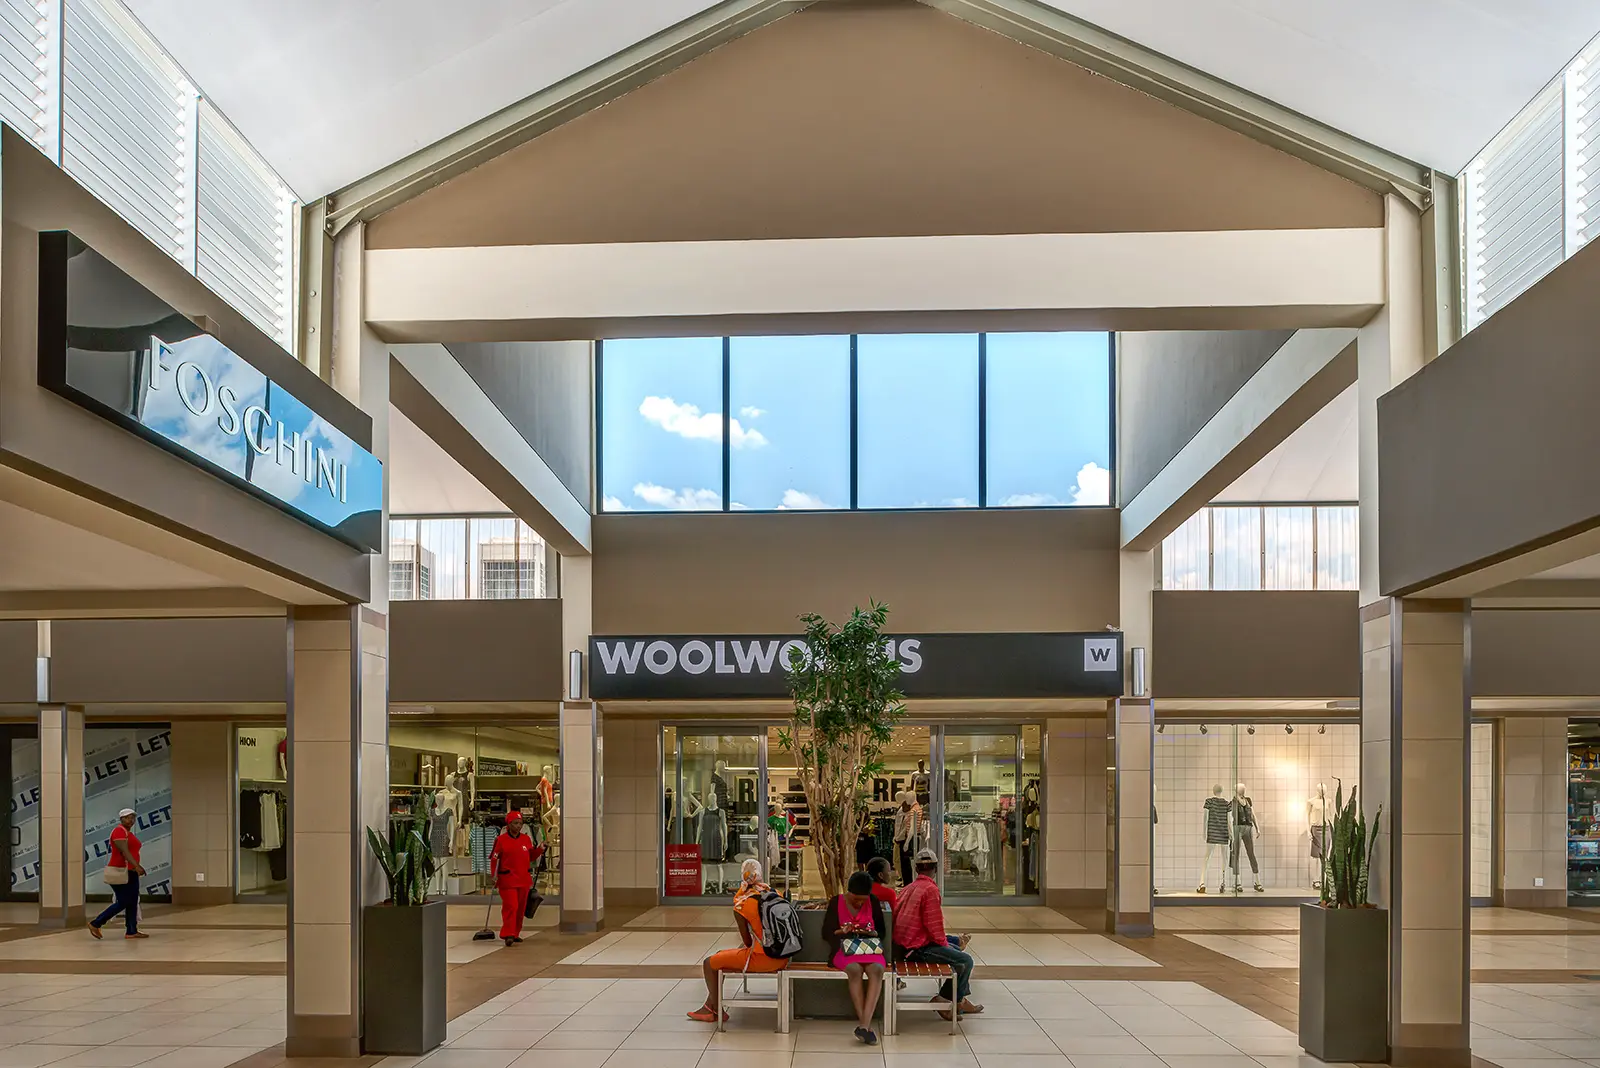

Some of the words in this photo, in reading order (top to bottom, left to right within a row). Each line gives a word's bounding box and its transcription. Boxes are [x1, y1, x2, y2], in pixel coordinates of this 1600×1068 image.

[149, 335, 347, 503] FOSCHINI
[596, 639, 922, 674] WOOLWOS
[137, 731, 171, 757] LET
[240, 736, 256, 747] HION
[94, 755, 129, 780] LET
[20, 786, 39, 807] LE
[138, 805, 171, 831] LET
[146, 879, 170, 896] ET
